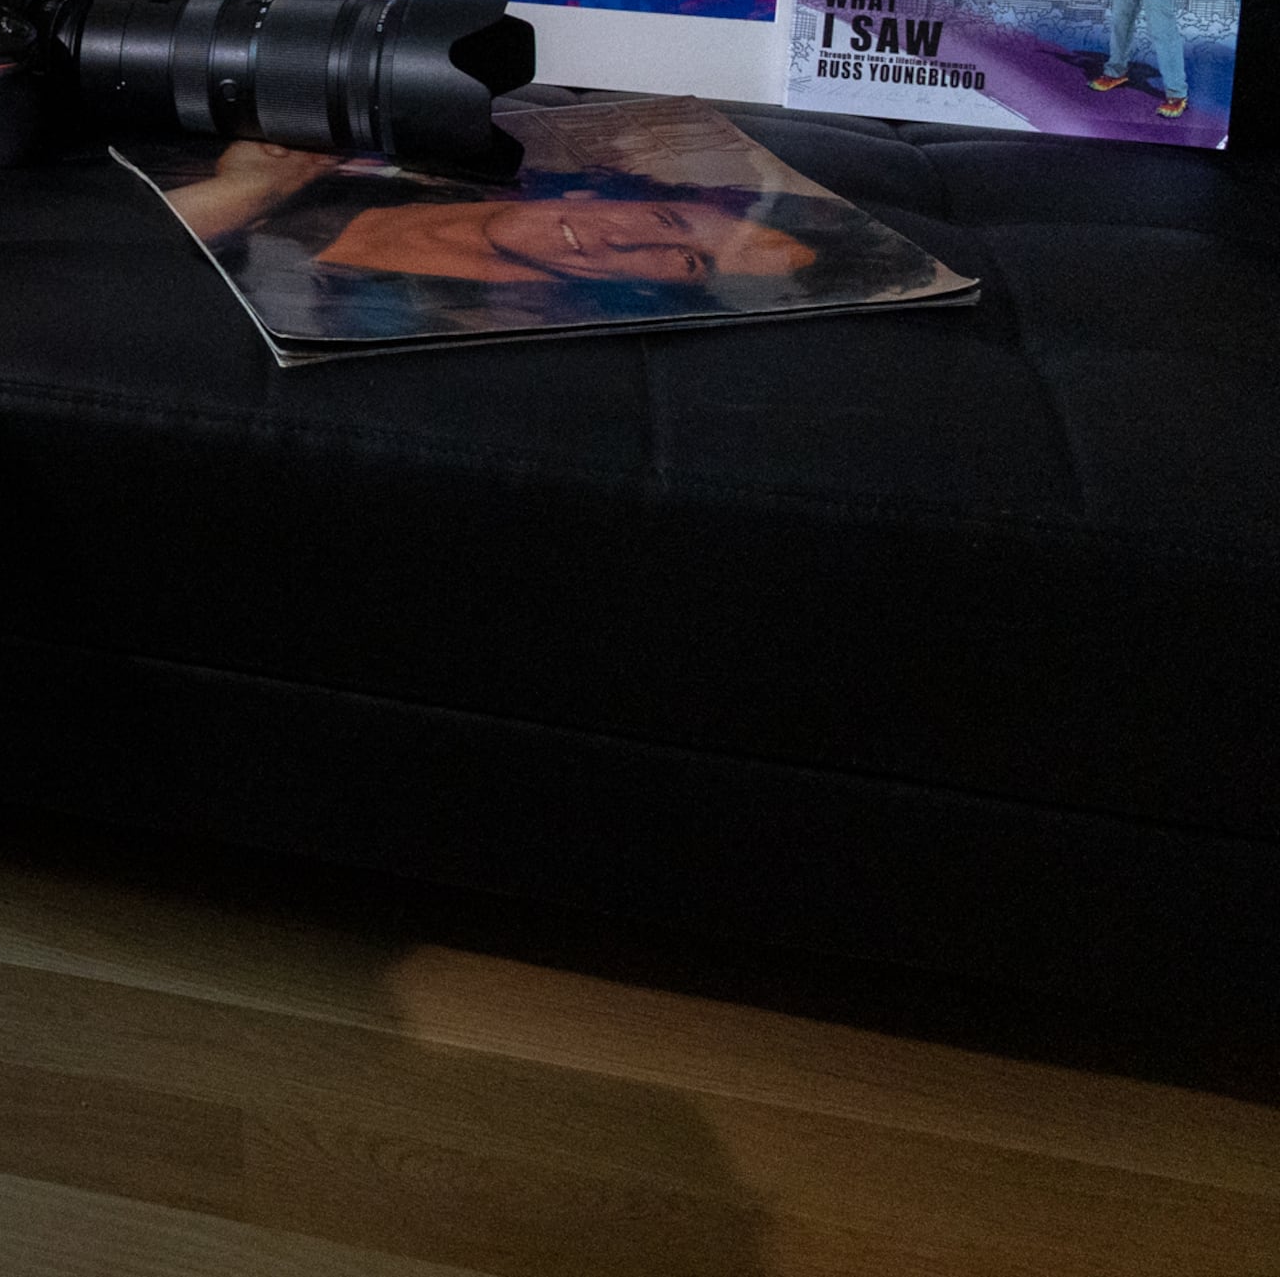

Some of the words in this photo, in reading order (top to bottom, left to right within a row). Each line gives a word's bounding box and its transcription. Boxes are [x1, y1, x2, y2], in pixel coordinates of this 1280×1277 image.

[822, 13, 835, 48] I
[850, 15, 944, 57] SAW
[819, 50, 852, 60] Through
[853, 53, 865, 62] my
[895, 56, 927, 67] lifetime
[817, 59, 863, 80] RUSS
[869, 63, 986, 90] YOUNGBLOOD
